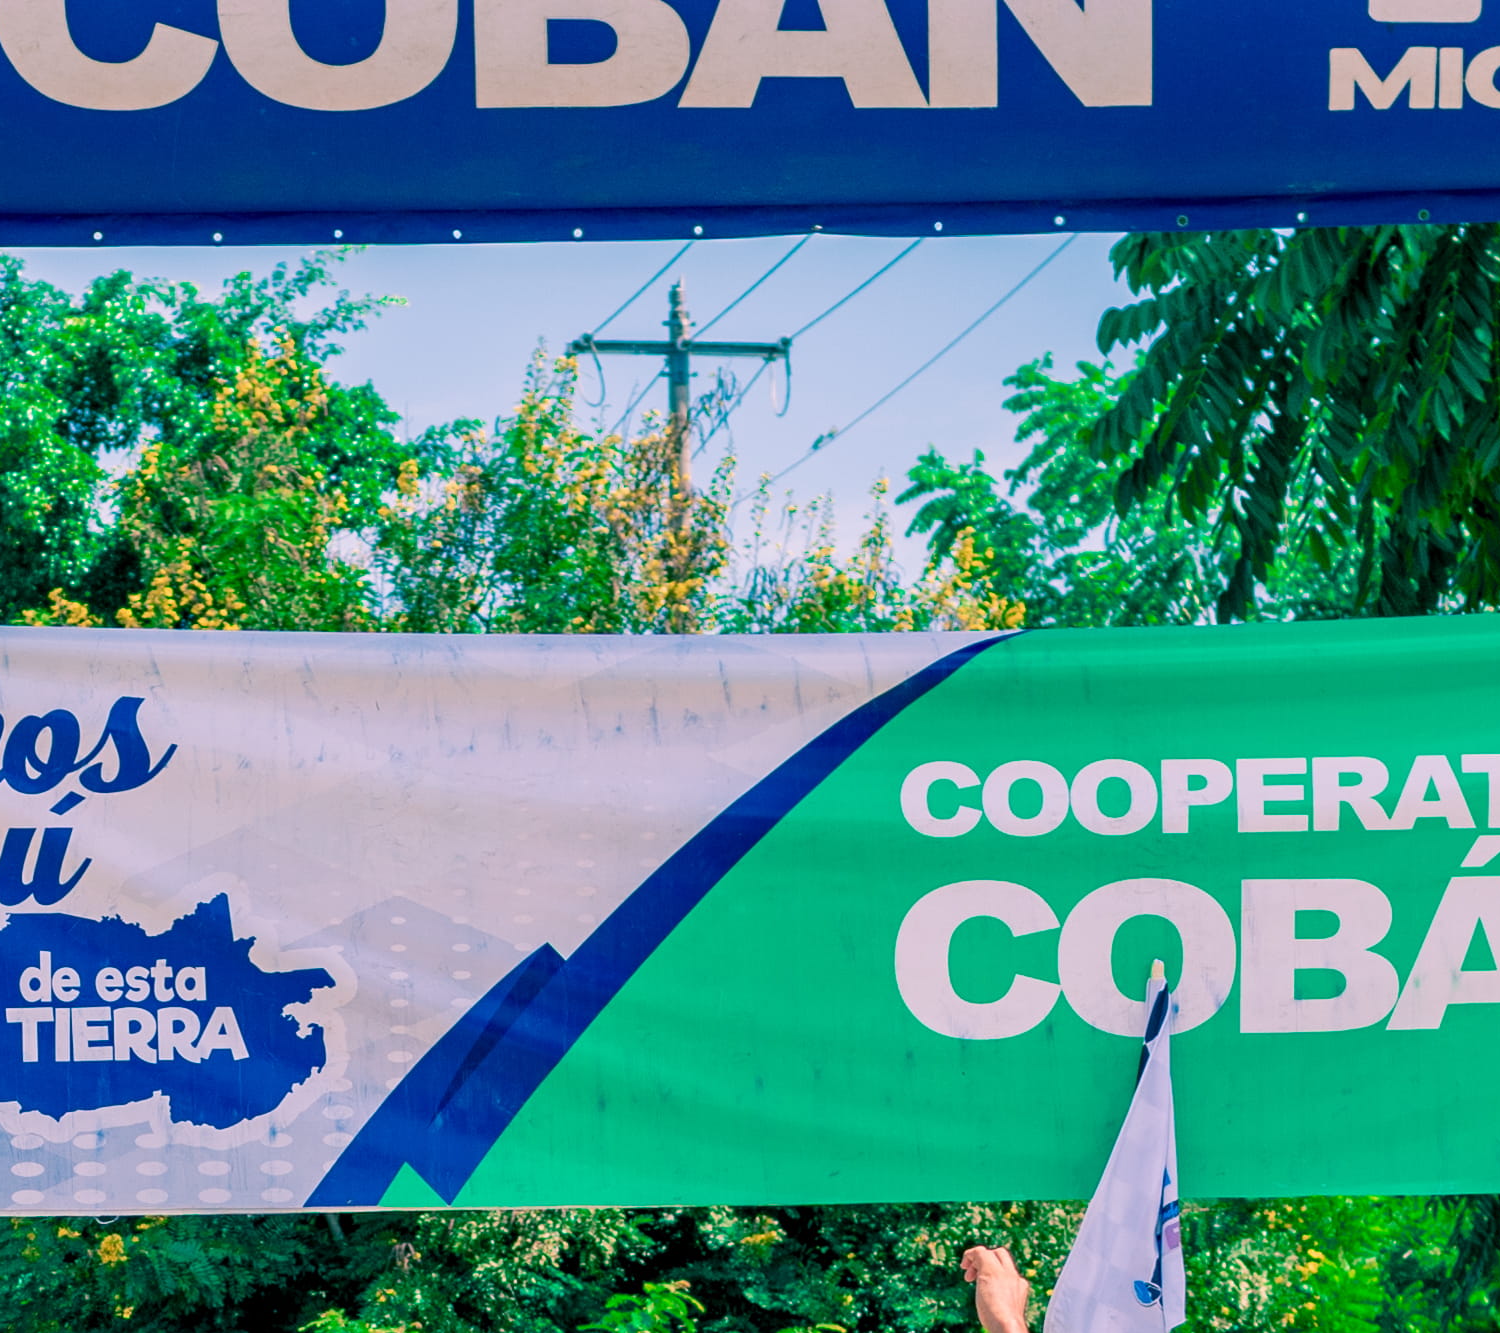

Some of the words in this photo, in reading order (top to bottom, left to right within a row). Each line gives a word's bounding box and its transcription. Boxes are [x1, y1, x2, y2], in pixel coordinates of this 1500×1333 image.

[18, 950, 81, 1000] de
[94, 958, 207, 1002] esta
[4, 1005, 250, 1063] TIERRA
